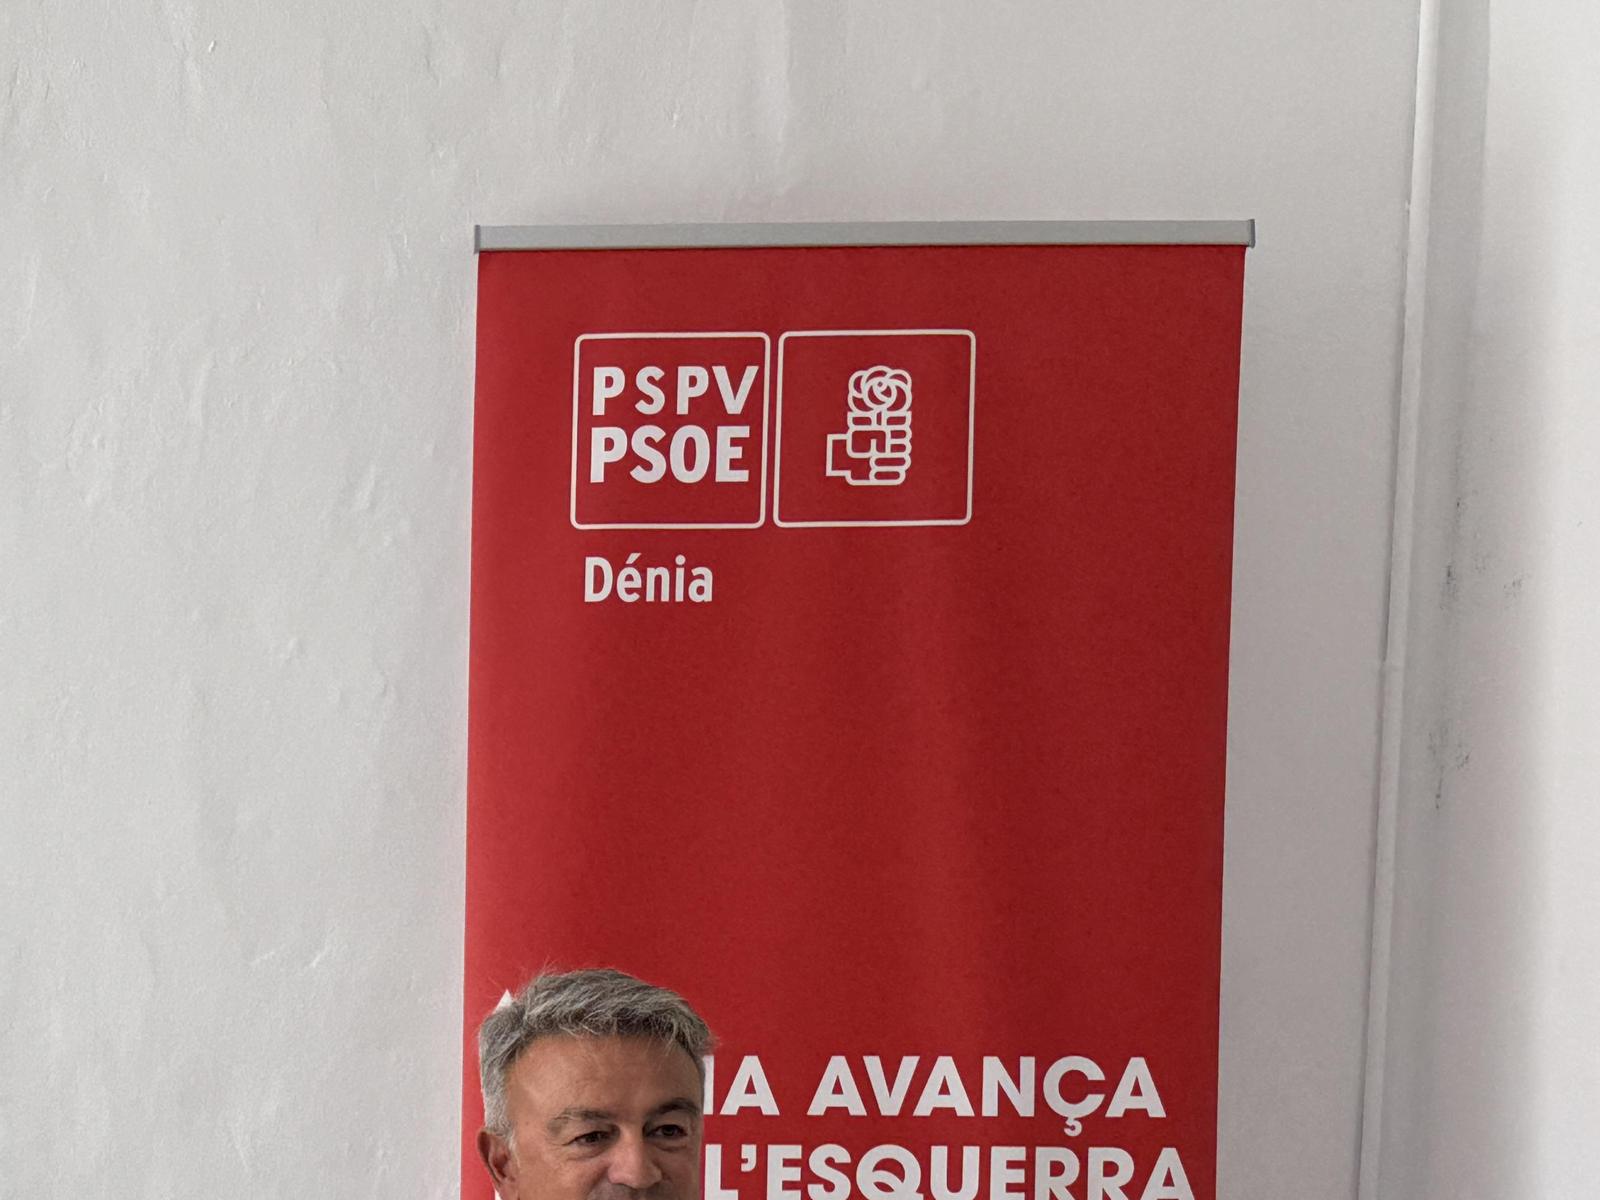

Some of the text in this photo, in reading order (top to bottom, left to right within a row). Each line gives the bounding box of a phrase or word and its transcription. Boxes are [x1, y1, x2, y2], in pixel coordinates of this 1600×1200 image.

[592, 365, 759, 416] PSPV
[589, 425, 751, 483] PSOE
[584, 552, 714, 602] Dénia
[807, 1055, 1167, 1137] AVANÇA
